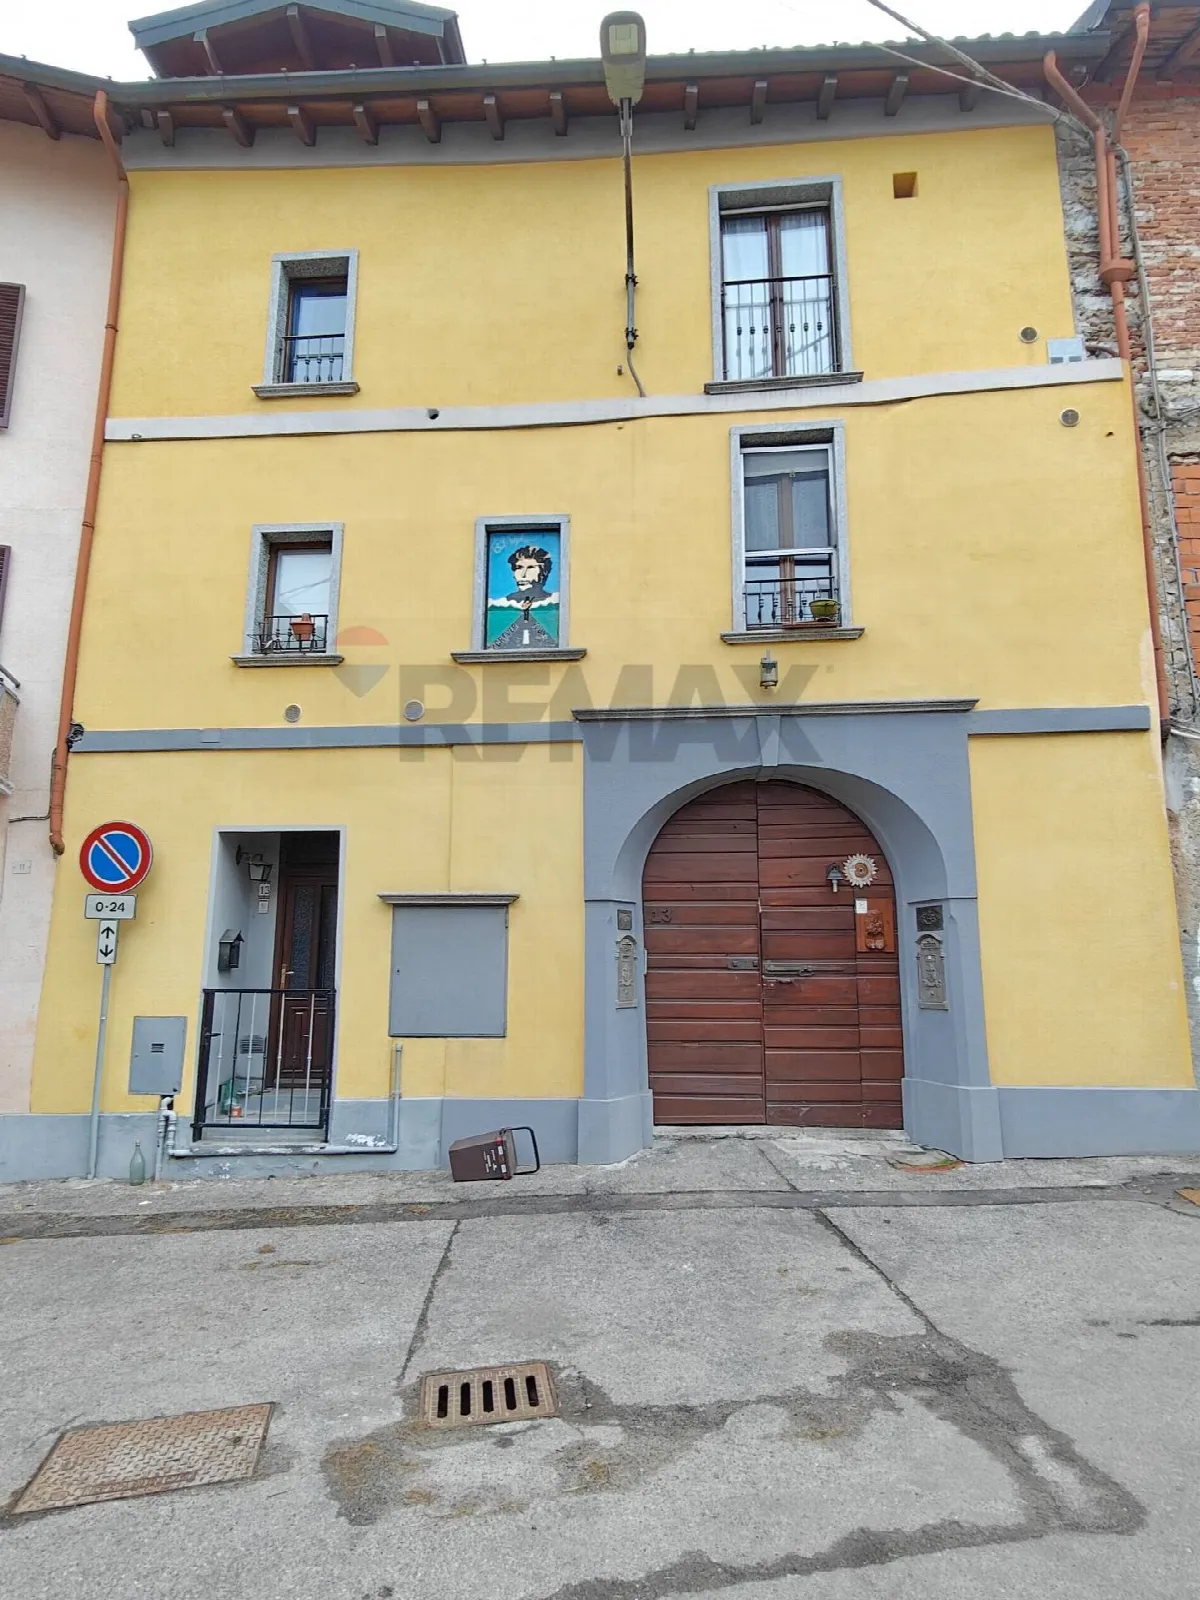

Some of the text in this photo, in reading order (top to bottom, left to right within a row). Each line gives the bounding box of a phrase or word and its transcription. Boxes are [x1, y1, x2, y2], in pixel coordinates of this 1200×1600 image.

[260, 885, 270, 895] 13
[95, 901, 126, 912] 0-24
[651, 908, 672, 923] 13
